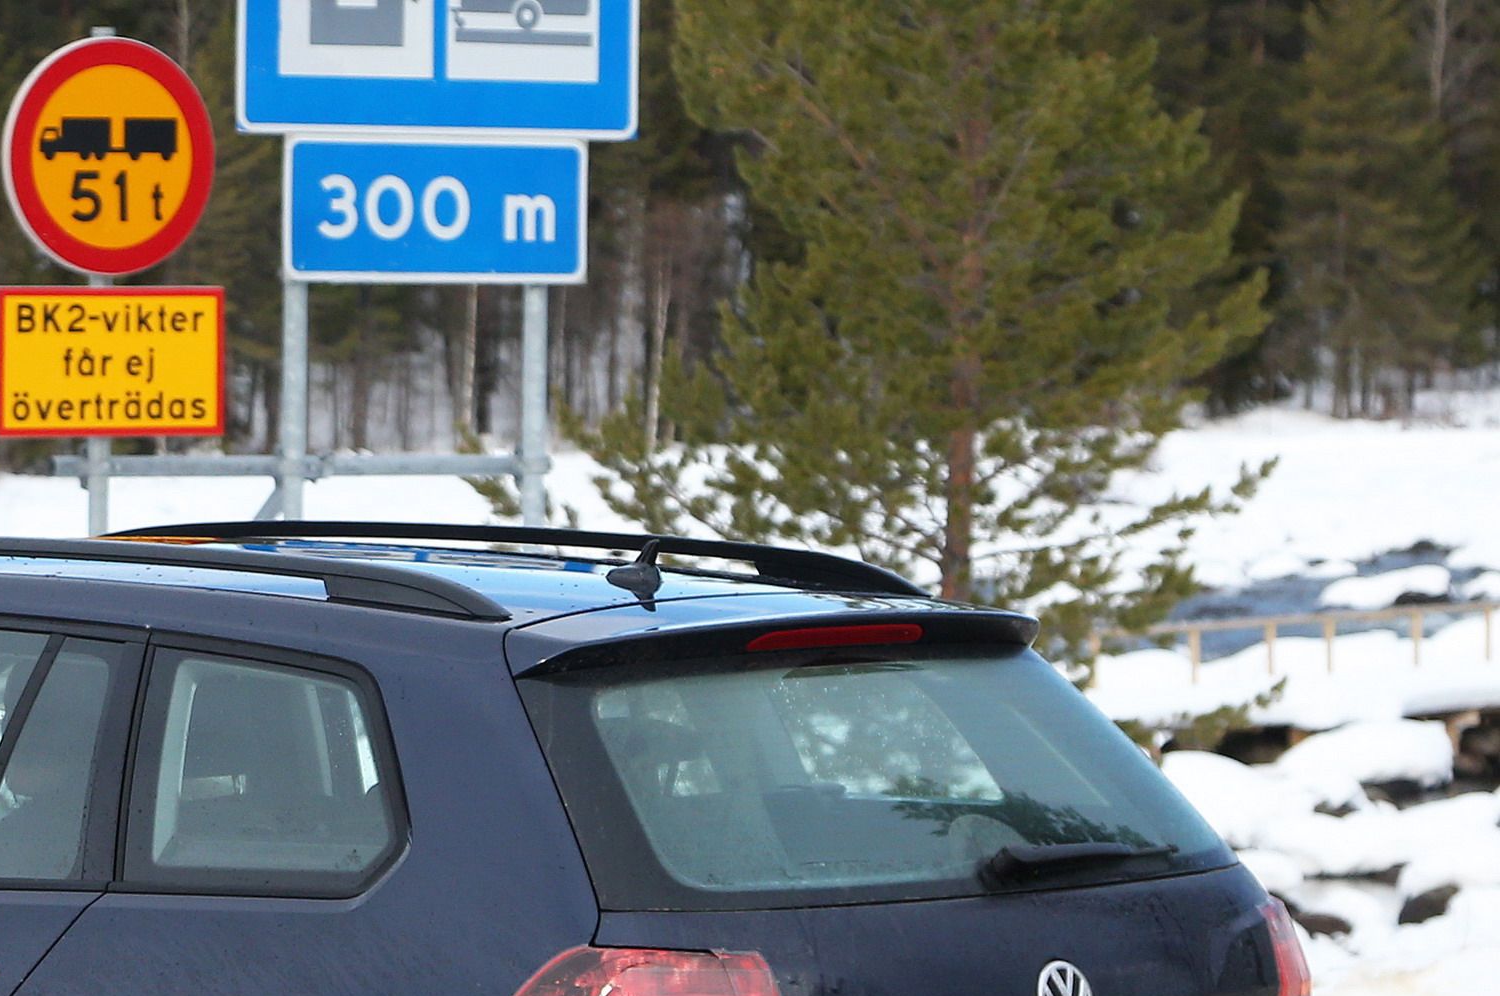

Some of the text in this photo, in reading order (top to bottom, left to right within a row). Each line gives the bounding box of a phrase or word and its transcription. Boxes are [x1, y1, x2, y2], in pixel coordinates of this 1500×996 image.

[70, 170, 164, 223] 51 t
[318, 174, 556, 242] 300 m
[17, 304, 204, 333] BK2-vikter
[63, 347, 155, 383] får ej
[13, 391, 206, 421] överträdas
